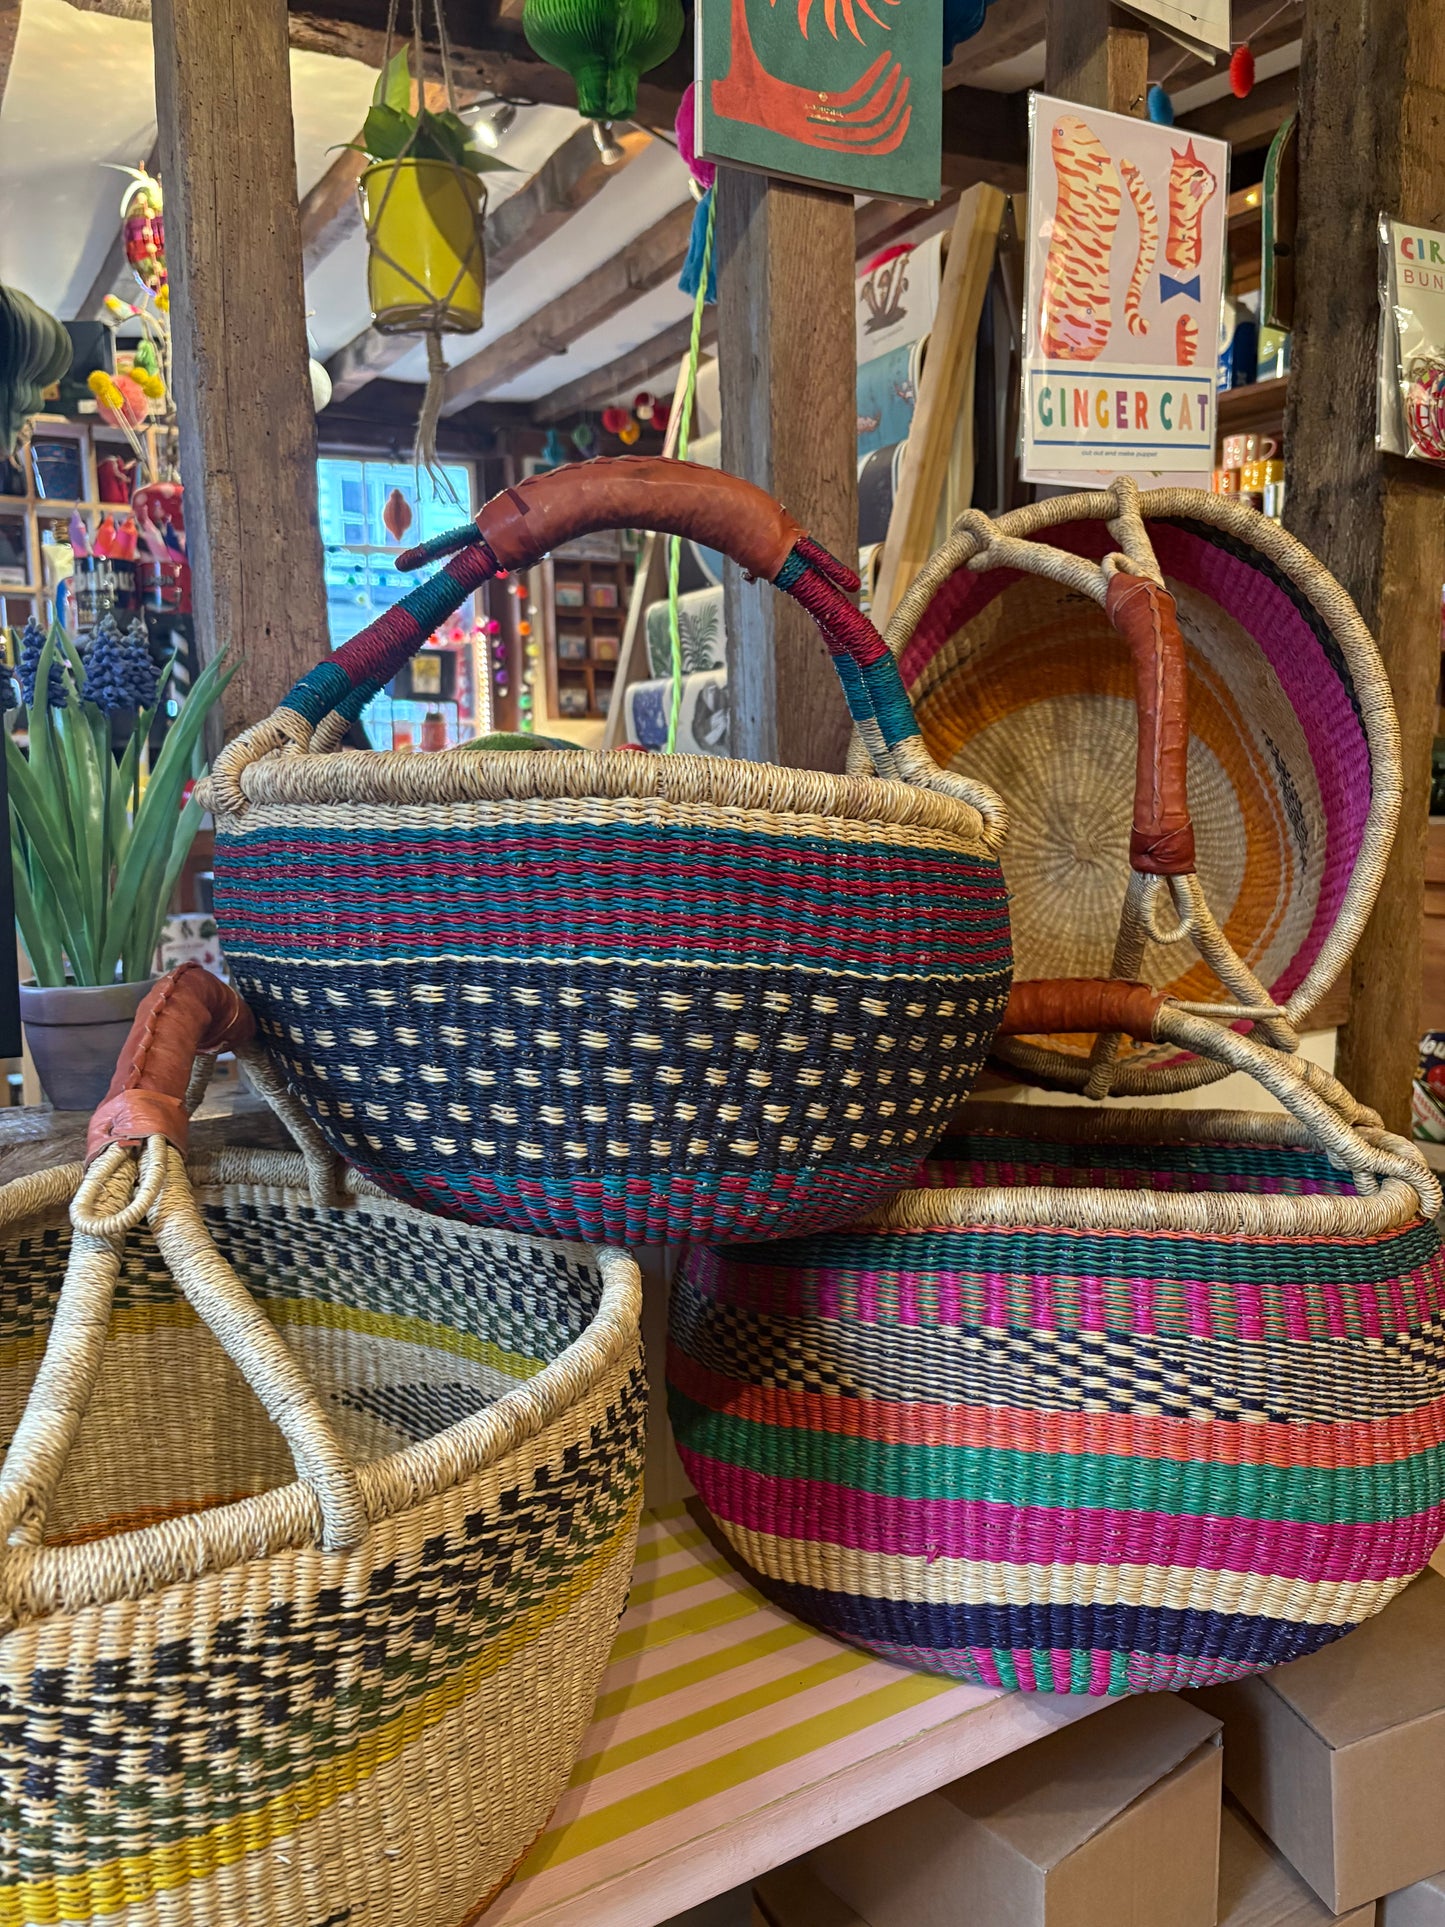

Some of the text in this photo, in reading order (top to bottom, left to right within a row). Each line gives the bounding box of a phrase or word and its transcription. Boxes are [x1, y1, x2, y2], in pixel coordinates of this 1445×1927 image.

[1400, 236, 1445, 265] CIR
[1403, 268, 1444, 290] BUN
[1038, 386, 1209, 431] GINGER CAT
